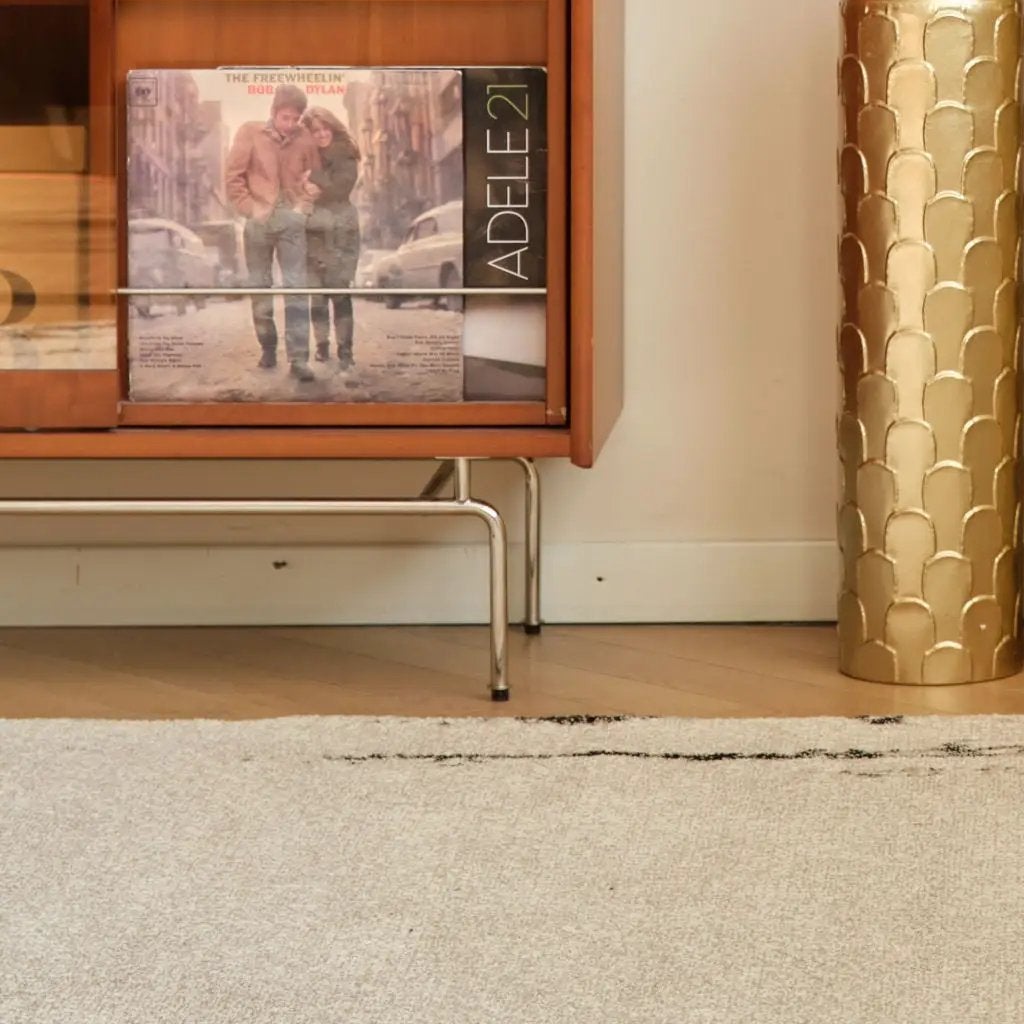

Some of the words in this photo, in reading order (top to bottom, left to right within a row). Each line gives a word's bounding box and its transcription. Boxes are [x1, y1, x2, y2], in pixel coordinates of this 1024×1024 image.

[225, 73, 250, 83] THE
[253, 72, 345, 83] FREEWHEELIN'
[247, 84, 274, 95] BOB
[305, 84, 345, 95] DYLAN
[487, 85, 529, 120] 21
[487, 128, 529, 280] ADELE
